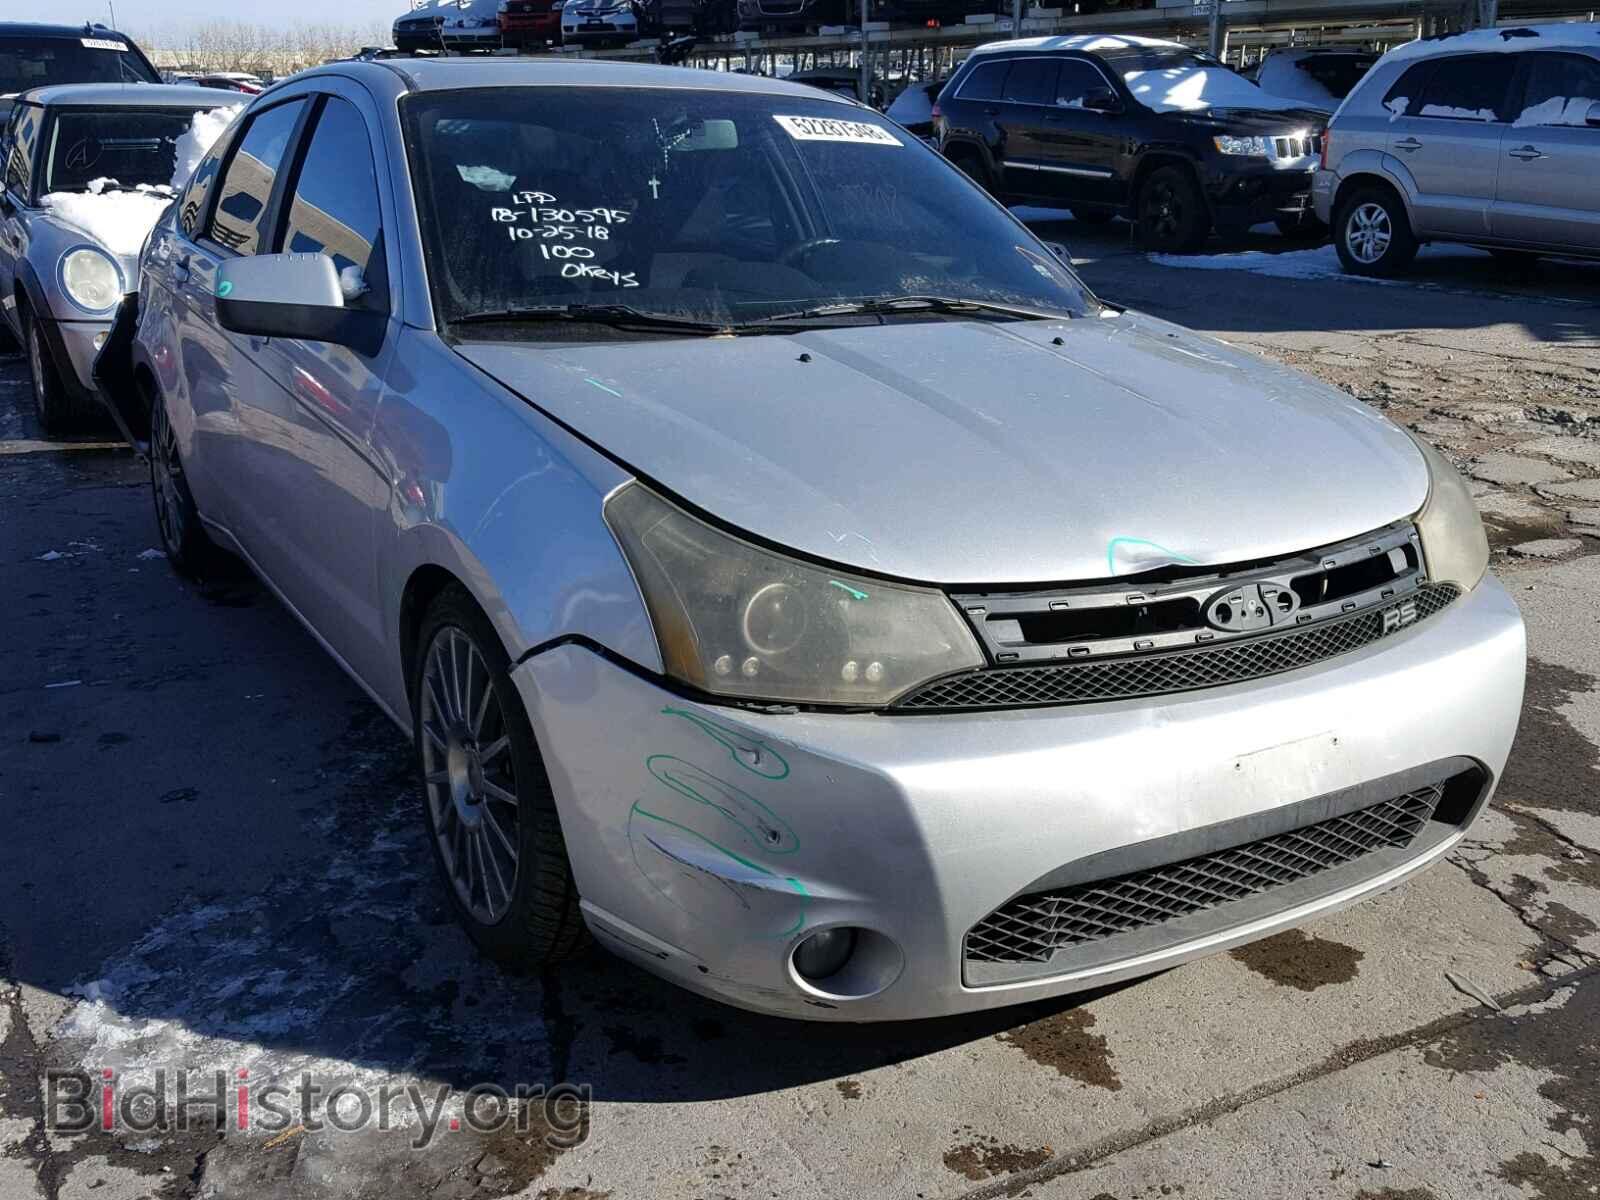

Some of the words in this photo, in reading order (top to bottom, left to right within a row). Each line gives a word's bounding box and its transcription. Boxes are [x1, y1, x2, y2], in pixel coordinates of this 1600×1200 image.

[512, 191, 557, 204] LPD
[491, 207, 631, 224] 18-130595
[508, 225, 609, 241] 10-25-18
[540, 244, 595, 260] 100
[1383, 602, 1417, 633] RS
